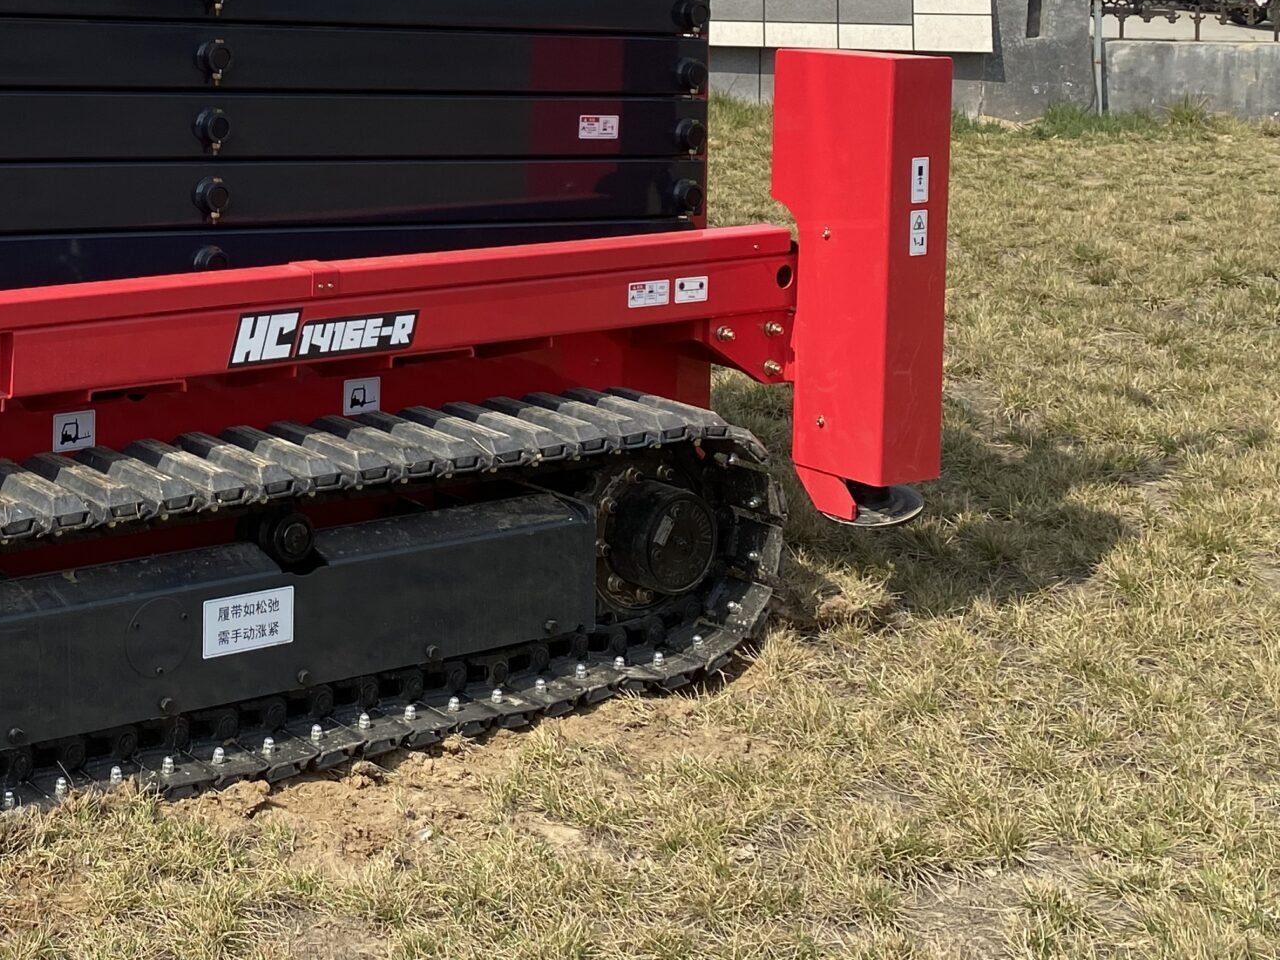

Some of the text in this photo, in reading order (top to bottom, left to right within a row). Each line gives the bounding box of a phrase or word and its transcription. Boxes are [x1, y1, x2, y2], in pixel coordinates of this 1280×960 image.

[231, 311, 417, 364] HC 1416E-R
[217, 597, 280, 622] 履带如松弛
[217, 621, 280, 646] 需手动涨紧
